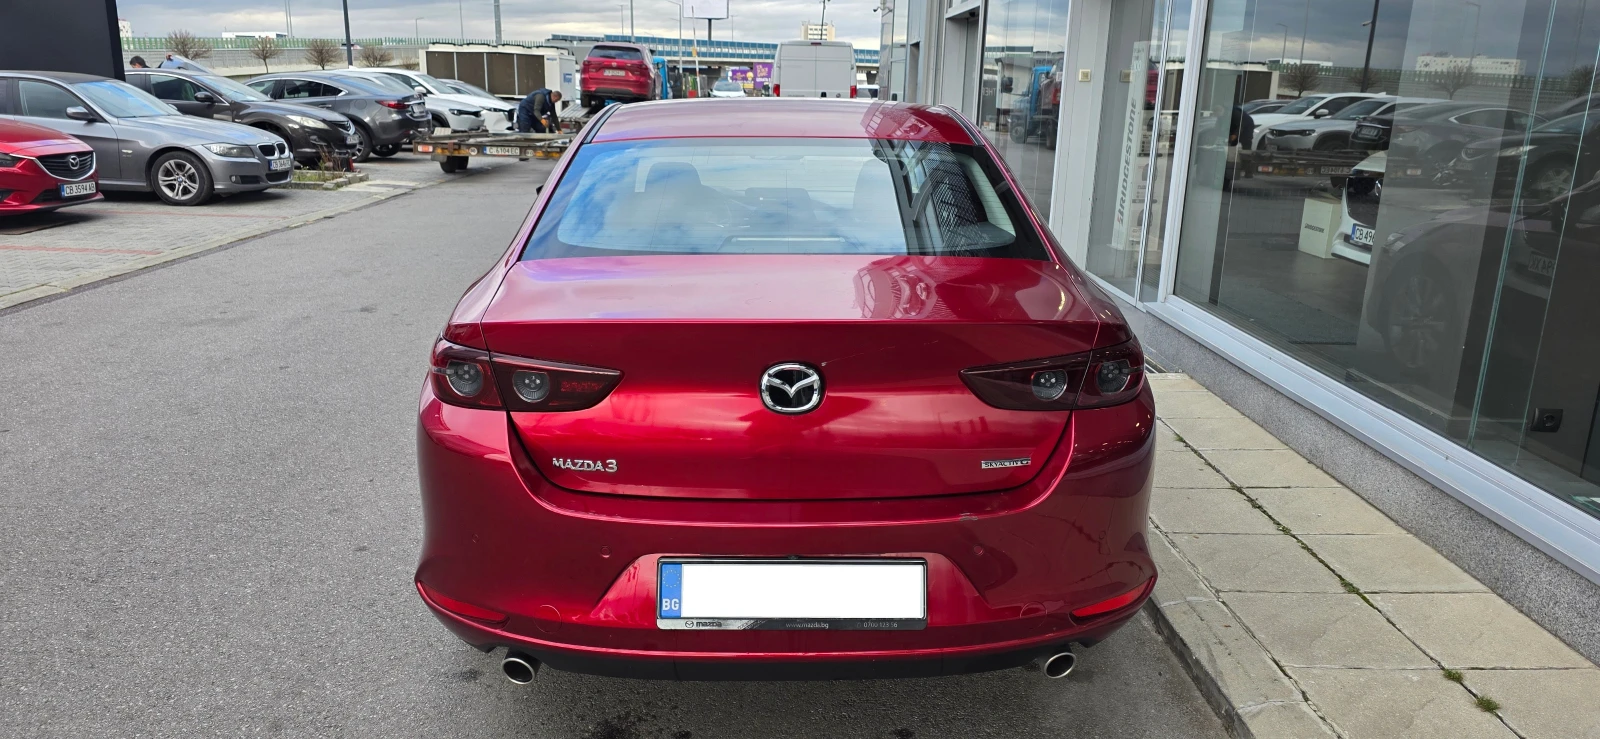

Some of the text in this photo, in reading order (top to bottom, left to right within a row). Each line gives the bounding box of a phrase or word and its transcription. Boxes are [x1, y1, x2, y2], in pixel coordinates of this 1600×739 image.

[1117, 97, 1138, 227] BRIDGESTONE
[66, 186, 74, 195] CB
[75, 184, 88, 194] 3594
[1355, 227, 1364, 240] CB
[662, 598, 680, 611] BG
[785, 621, 829, 630] www.mazda.bg
